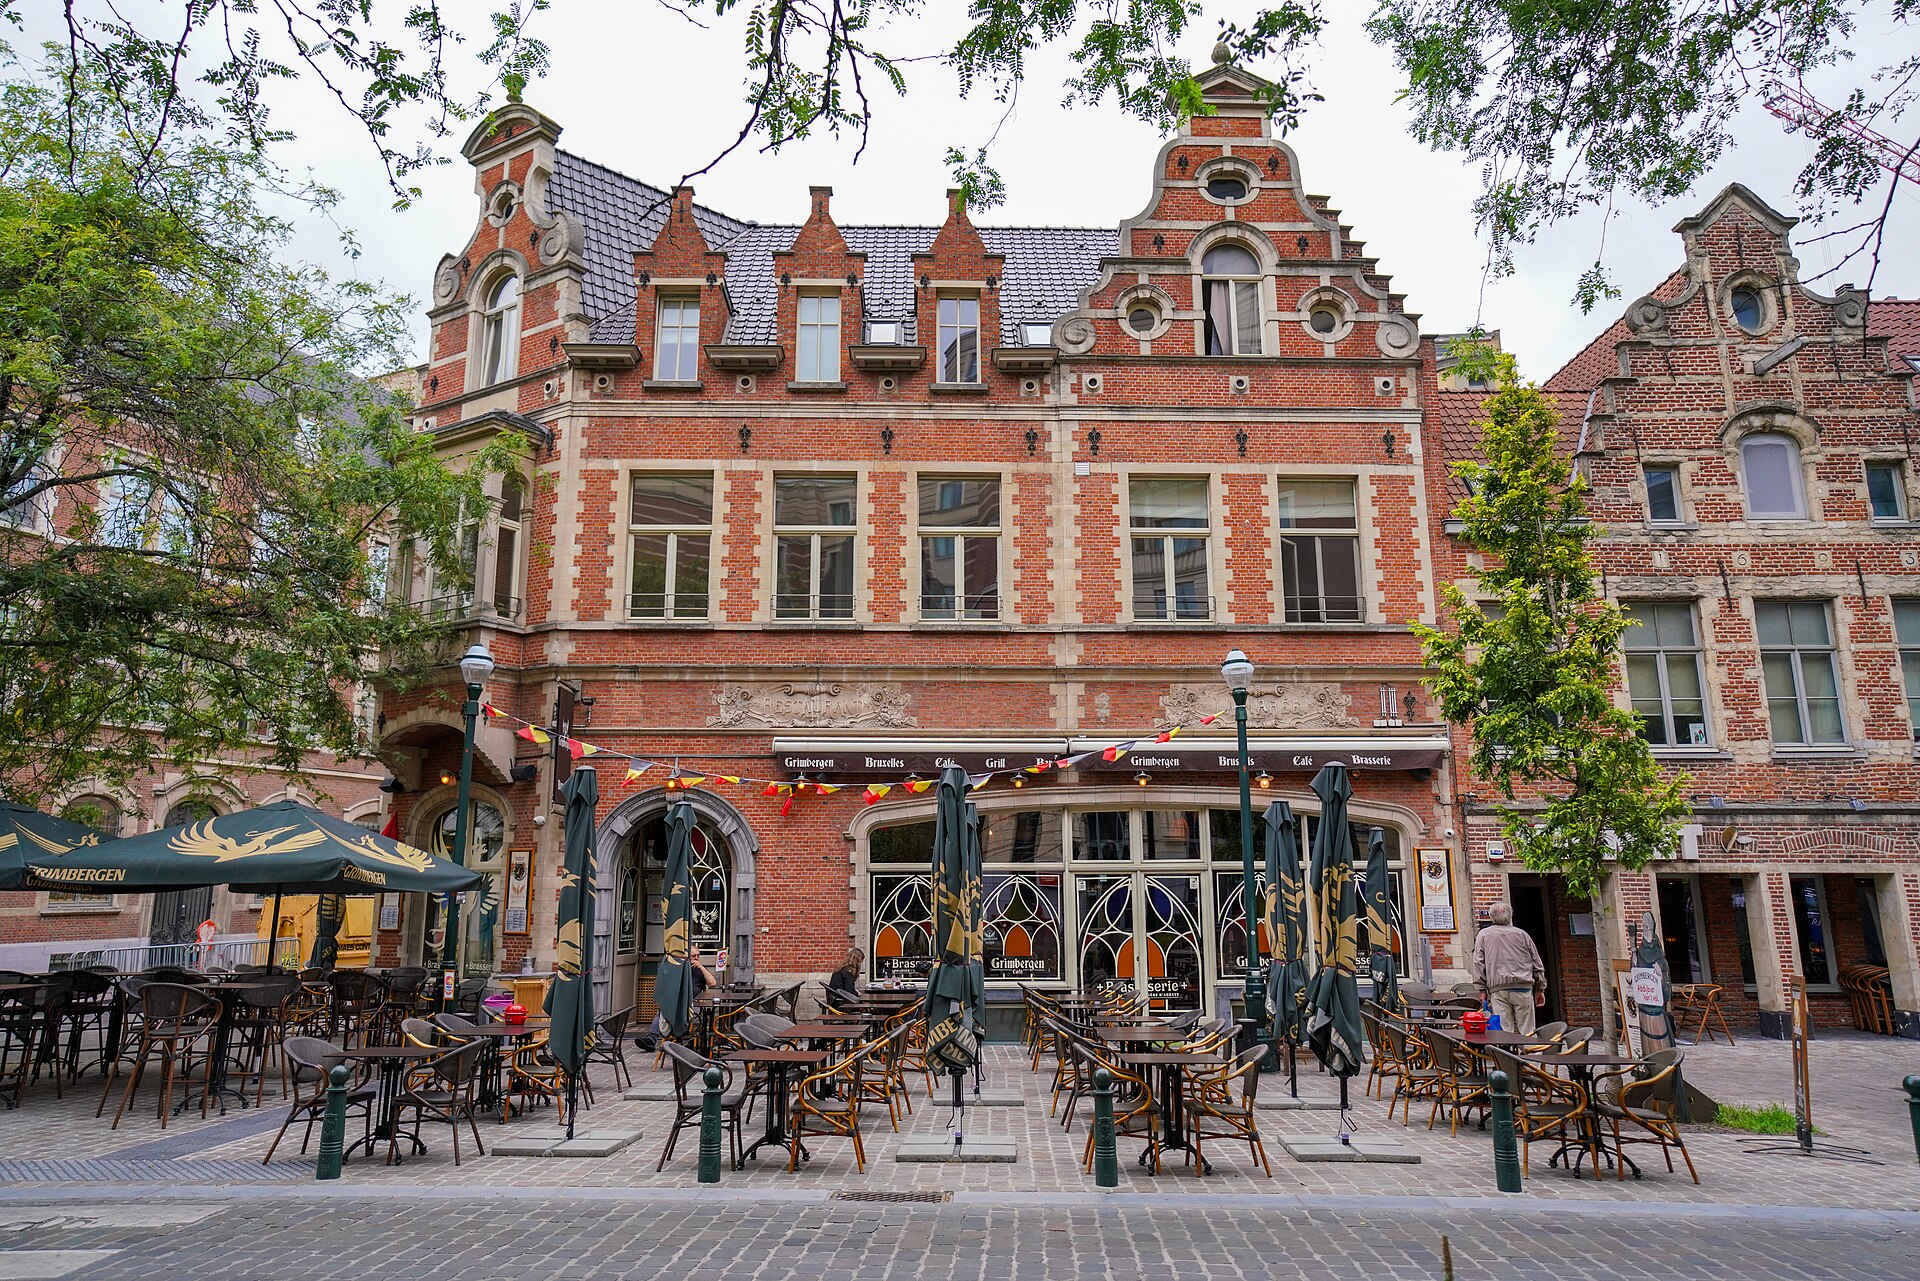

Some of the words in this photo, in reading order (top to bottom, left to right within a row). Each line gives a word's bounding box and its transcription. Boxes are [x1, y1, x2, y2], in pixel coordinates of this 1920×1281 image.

[784, 757, 834, 769] Grimbergen
[865, 756, 905, 768] Bruxelles
[935, 757, 956, 768] Café
[985, 757, 1006, 768] Grill
[1130, 756, 1180, 768] Grimbergen
[1218, 755, 1255, 766] Brusls
[1292, 755, 1313, 766] Café
[1351, 754, 1391, 765] Brasserie
[990, 957, 1045, 971] Grimbergen
